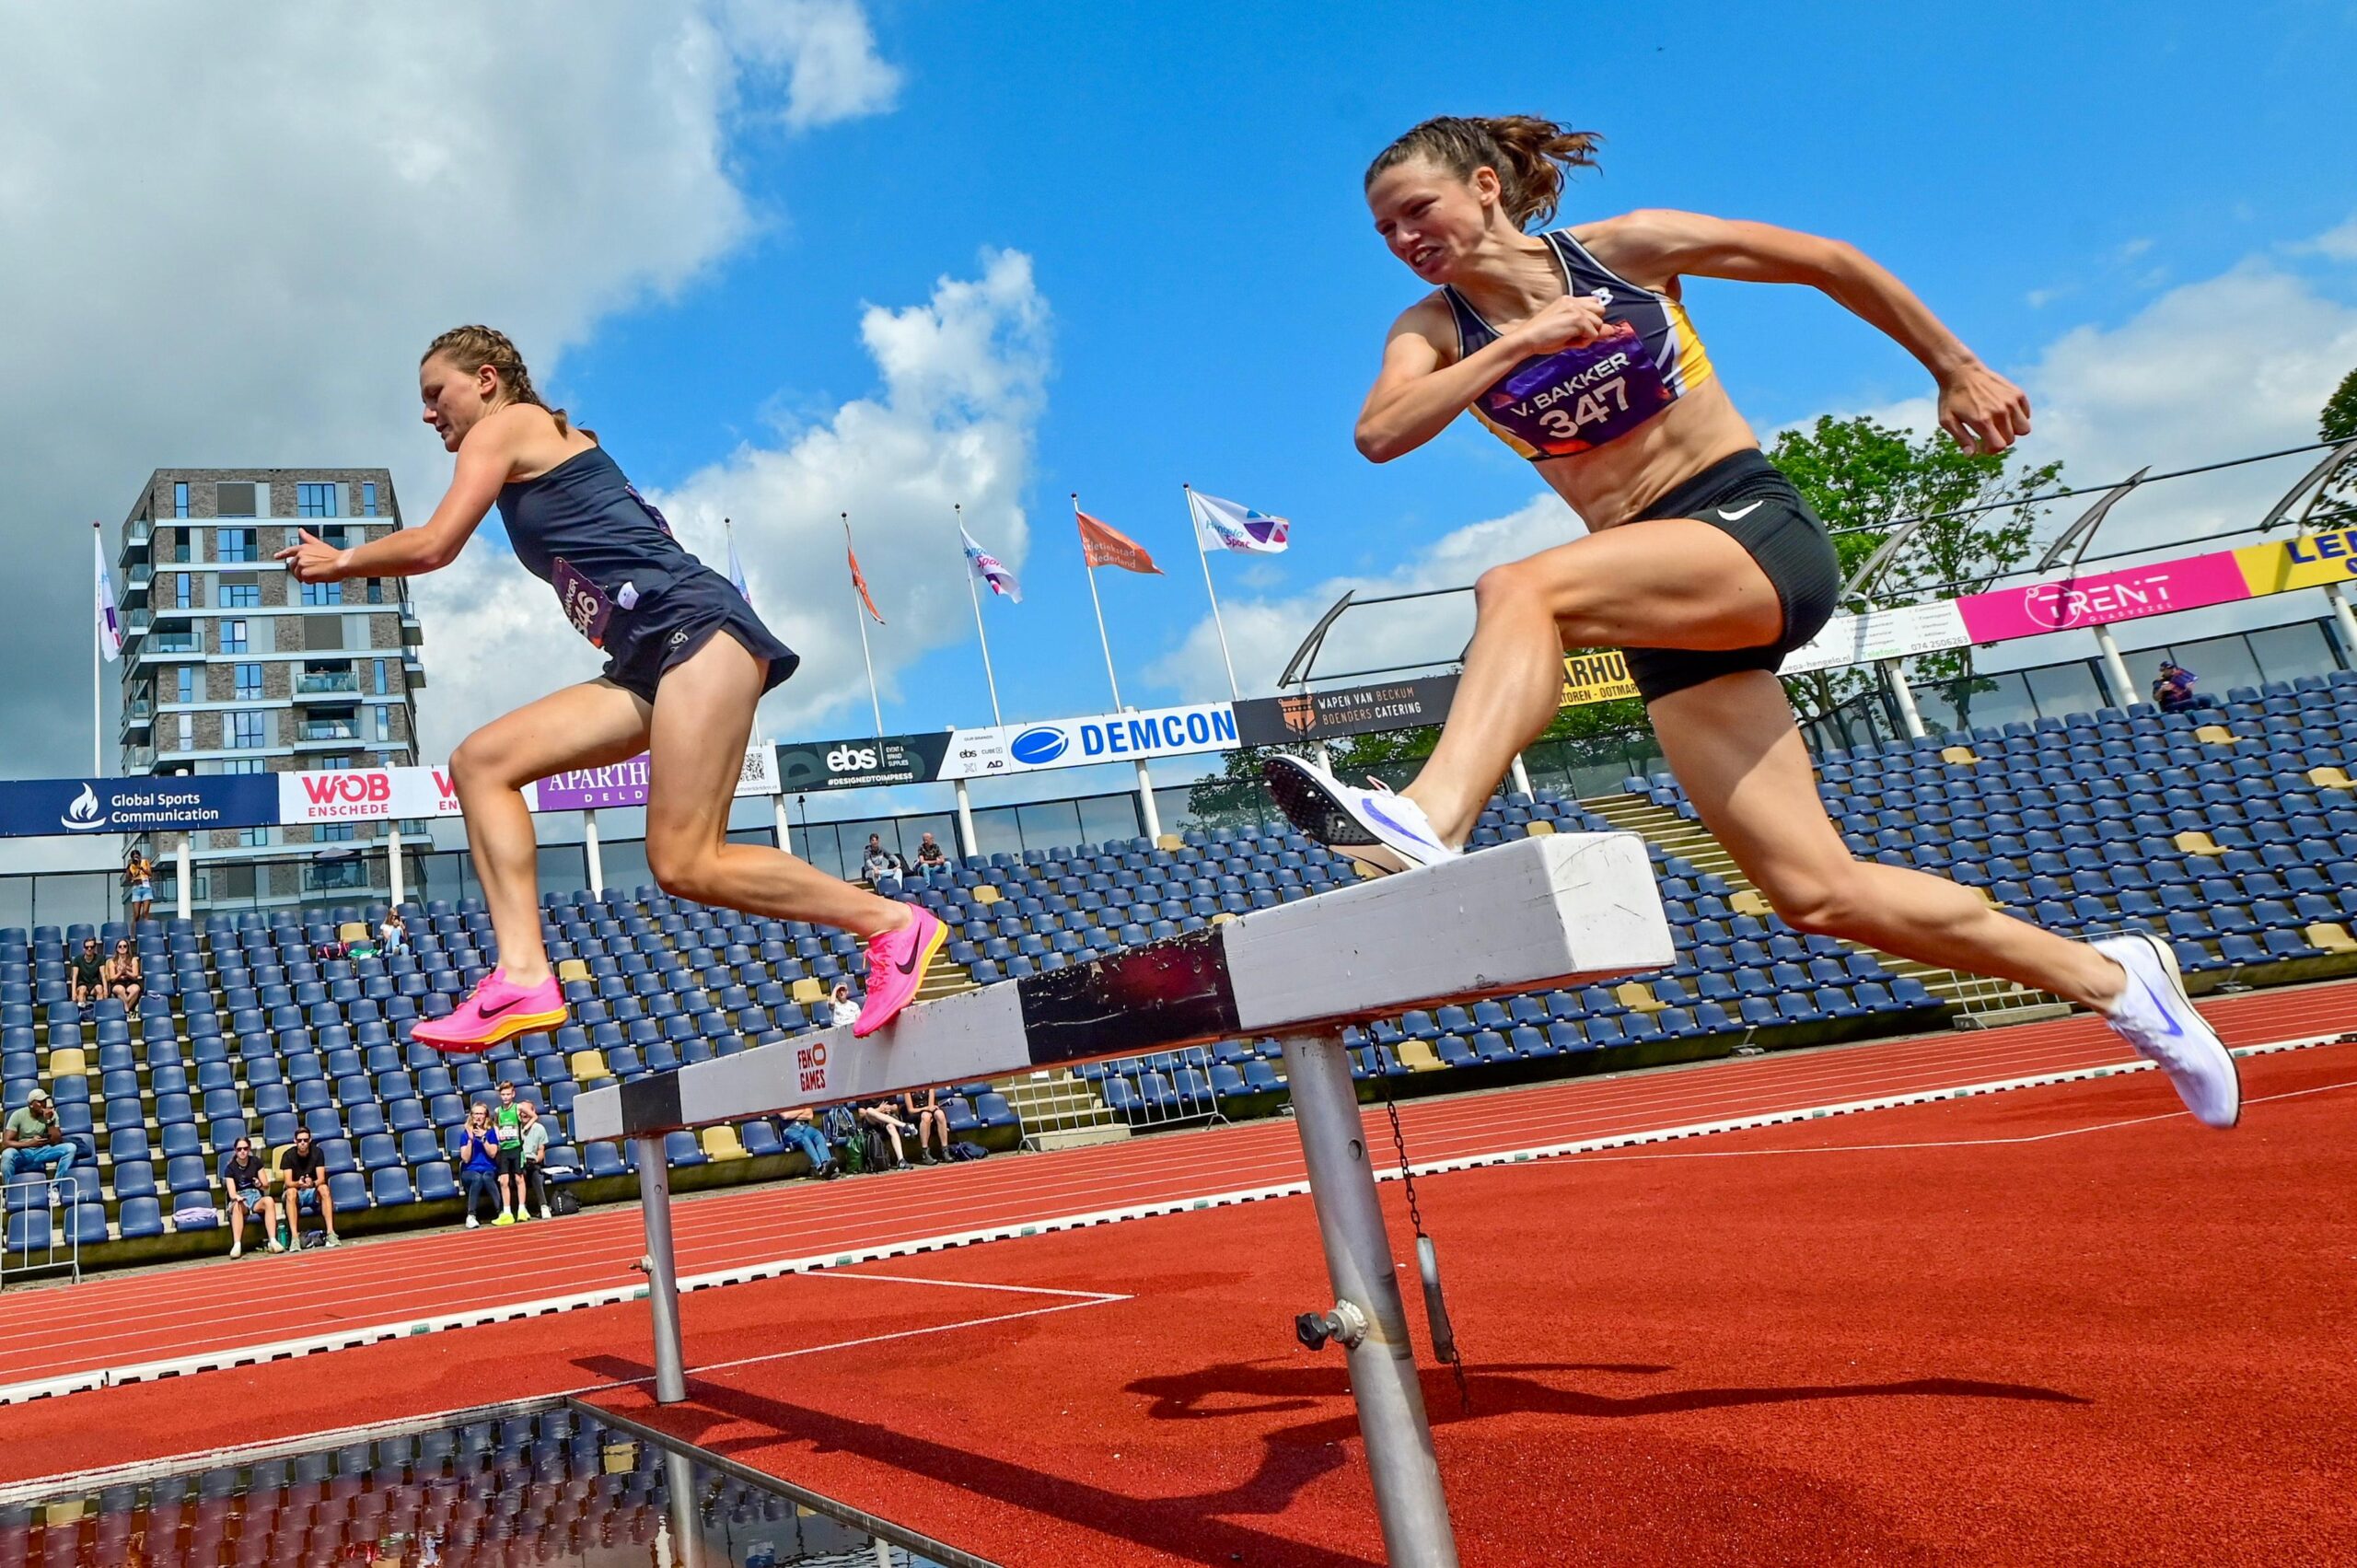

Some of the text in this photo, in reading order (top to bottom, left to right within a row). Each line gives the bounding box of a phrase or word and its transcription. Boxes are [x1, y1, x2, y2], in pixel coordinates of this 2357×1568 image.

[1510, 353, 1631, 417] V. BAKKER
[1538, 376, 1629, 438] 347
[2038, 575, 2169, 619] TRENT
[1910, 642, 1929, 651] 074
[1318, 686, 1415, 710] WAPEN VAN BECKUM
[1322, 702, 1422, 726] BOENDERS CATERING
[1080, 710, 1237, 756] DEMCON
[827, 744, 877, 772] ebs
[959, 749, 978, 759] ebs
[986, 760, 1004, 769] AD
[301, 773, 390, 804] WOB
[549, 761, 650, 792] APARTH
[828, 772, 913, 785] #DESIGNEDTOIMPRESS
[111, 793, 201, 808] Global Sports
[308, 803, 389, 818] ENSCHEDE
[111, 807, 219, 823] Communication
[797, 1048, 814, 1070] FBK
[799, 1069, 826, 1093] GAMES
